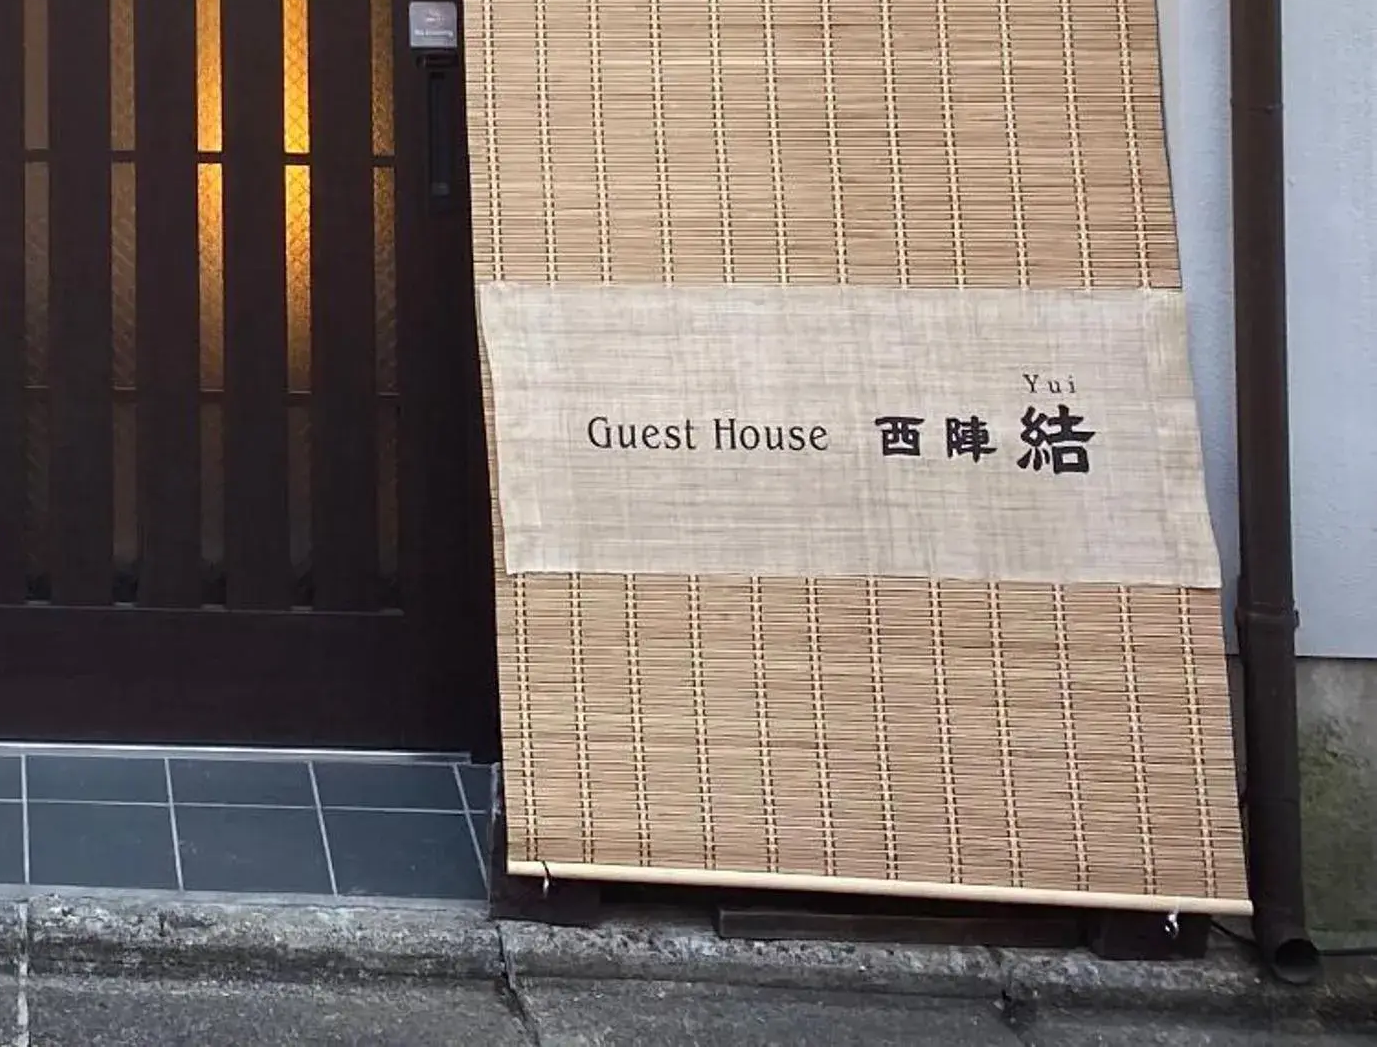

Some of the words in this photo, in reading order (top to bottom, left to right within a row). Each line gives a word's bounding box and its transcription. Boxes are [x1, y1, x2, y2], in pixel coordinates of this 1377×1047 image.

[1022, 373, 1078, 394] Yui
[587, 416, 697, 450] Guest
[713, 417, 829, 451] House
[874, 404, 1096, 474] 西陣結
